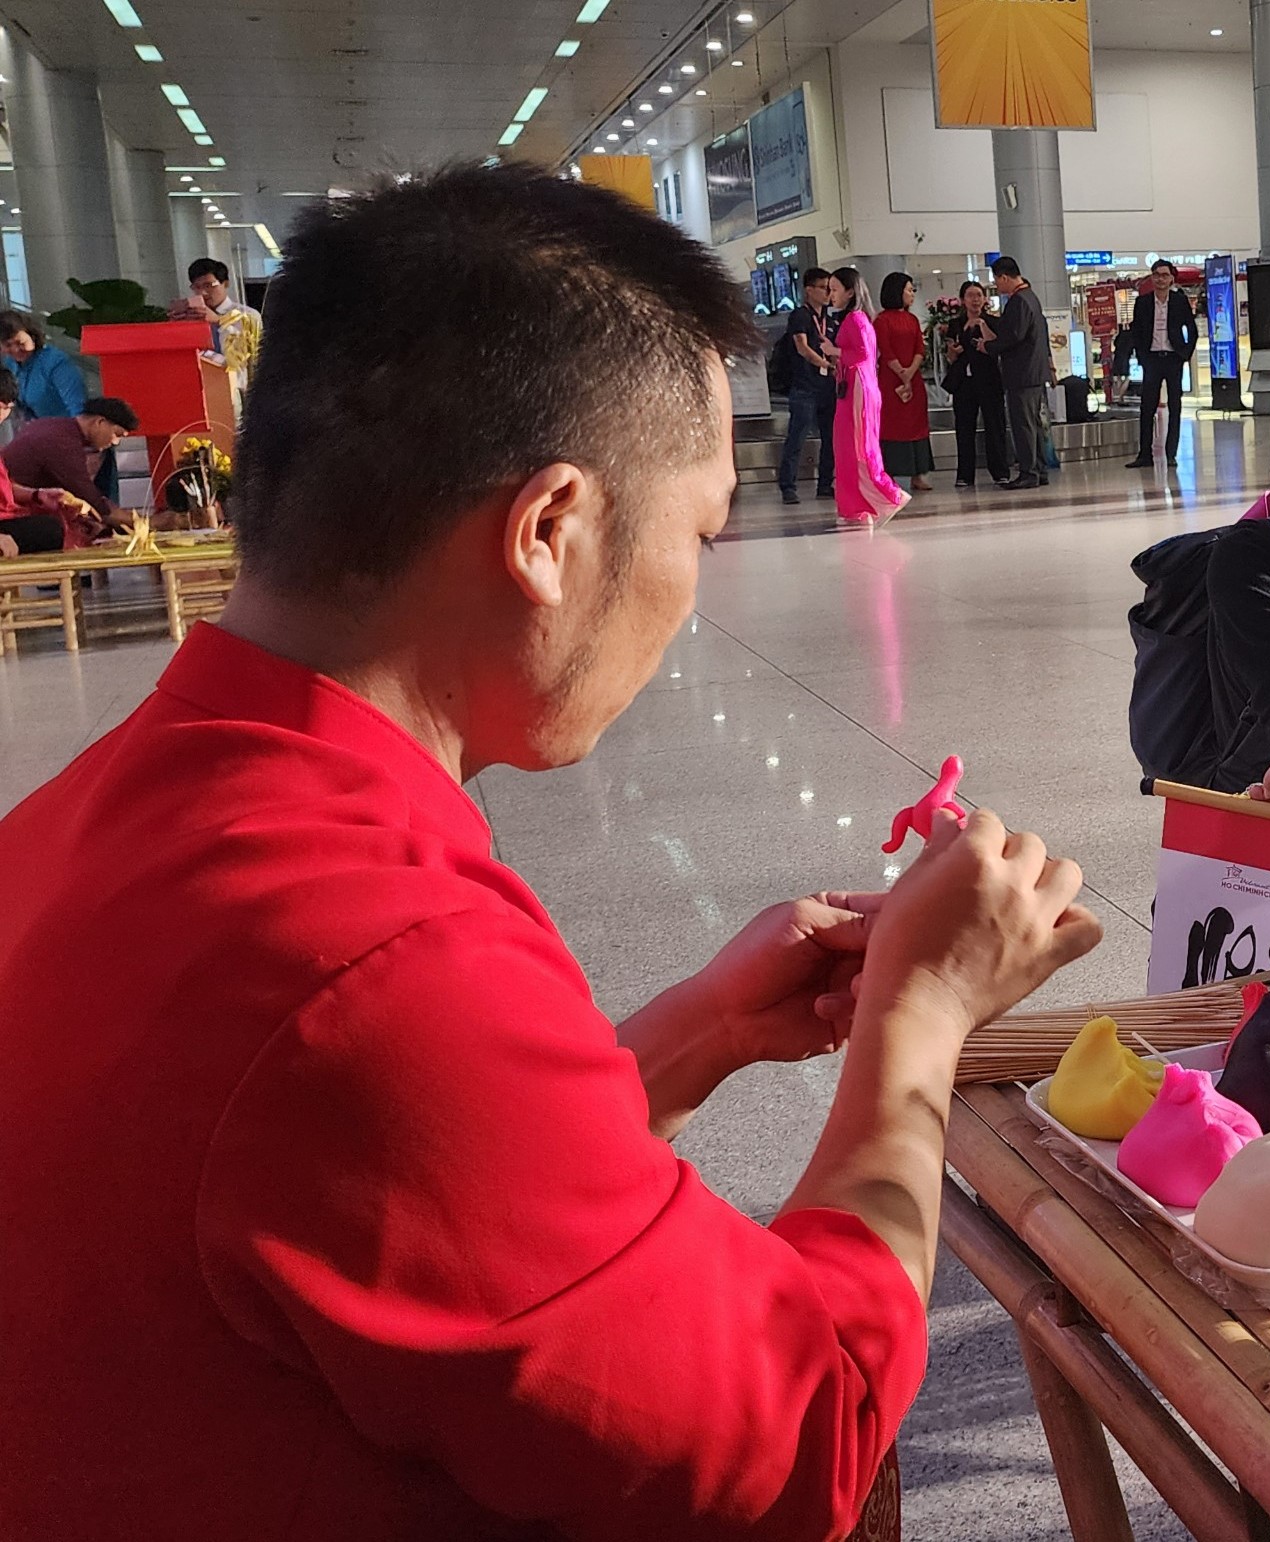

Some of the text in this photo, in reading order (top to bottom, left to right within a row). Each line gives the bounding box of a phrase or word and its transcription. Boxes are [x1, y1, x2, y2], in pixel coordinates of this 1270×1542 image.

[1221, 881, 1232, 889] HO
[1233, 883, 1245, 892] CHI
[1245, 886, 1264, 897] MINH
